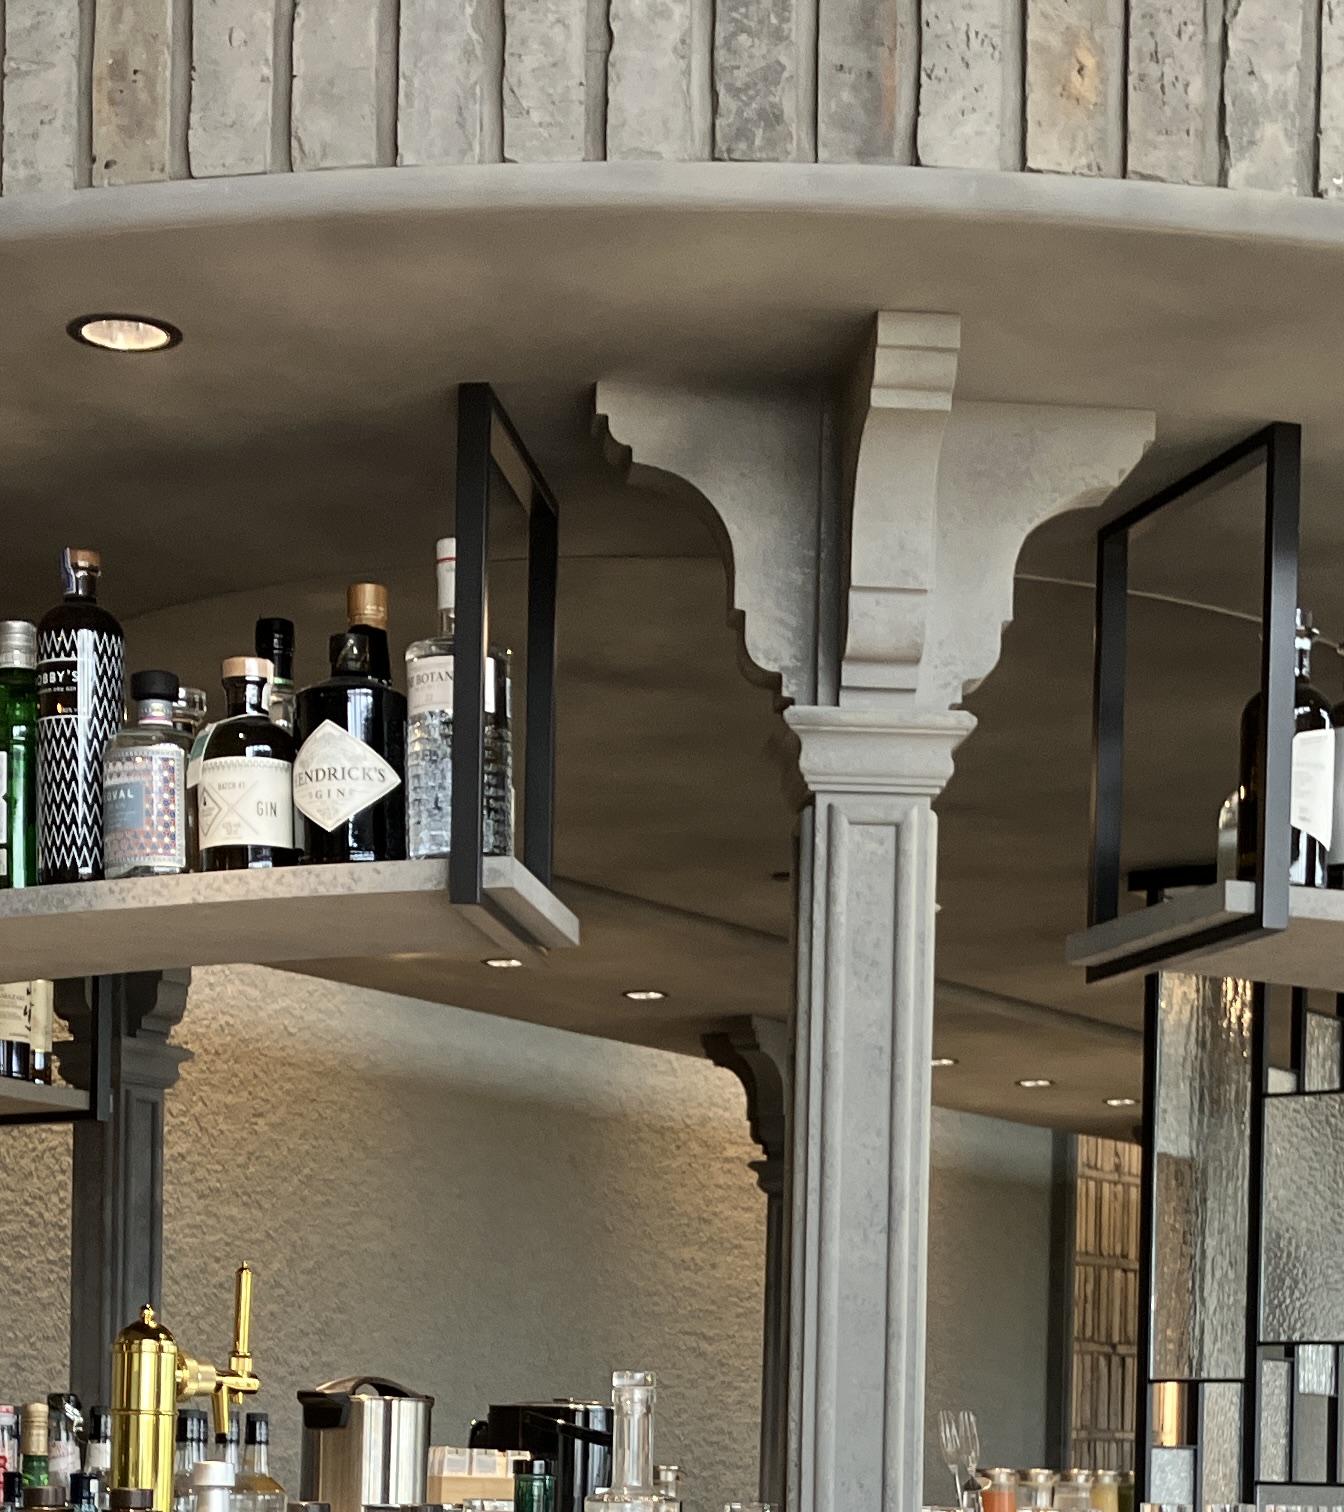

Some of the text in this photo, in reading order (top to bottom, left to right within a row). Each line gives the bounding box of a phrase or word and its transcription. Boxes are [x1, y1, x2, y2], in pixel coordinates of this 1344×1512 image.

[416, 671, 454, 685] BOTAN
[296, 766, 386, 787] ENDRICK'S
[315, 788, 346, 799] GIN
[256, 801, 277, 817] GIN
